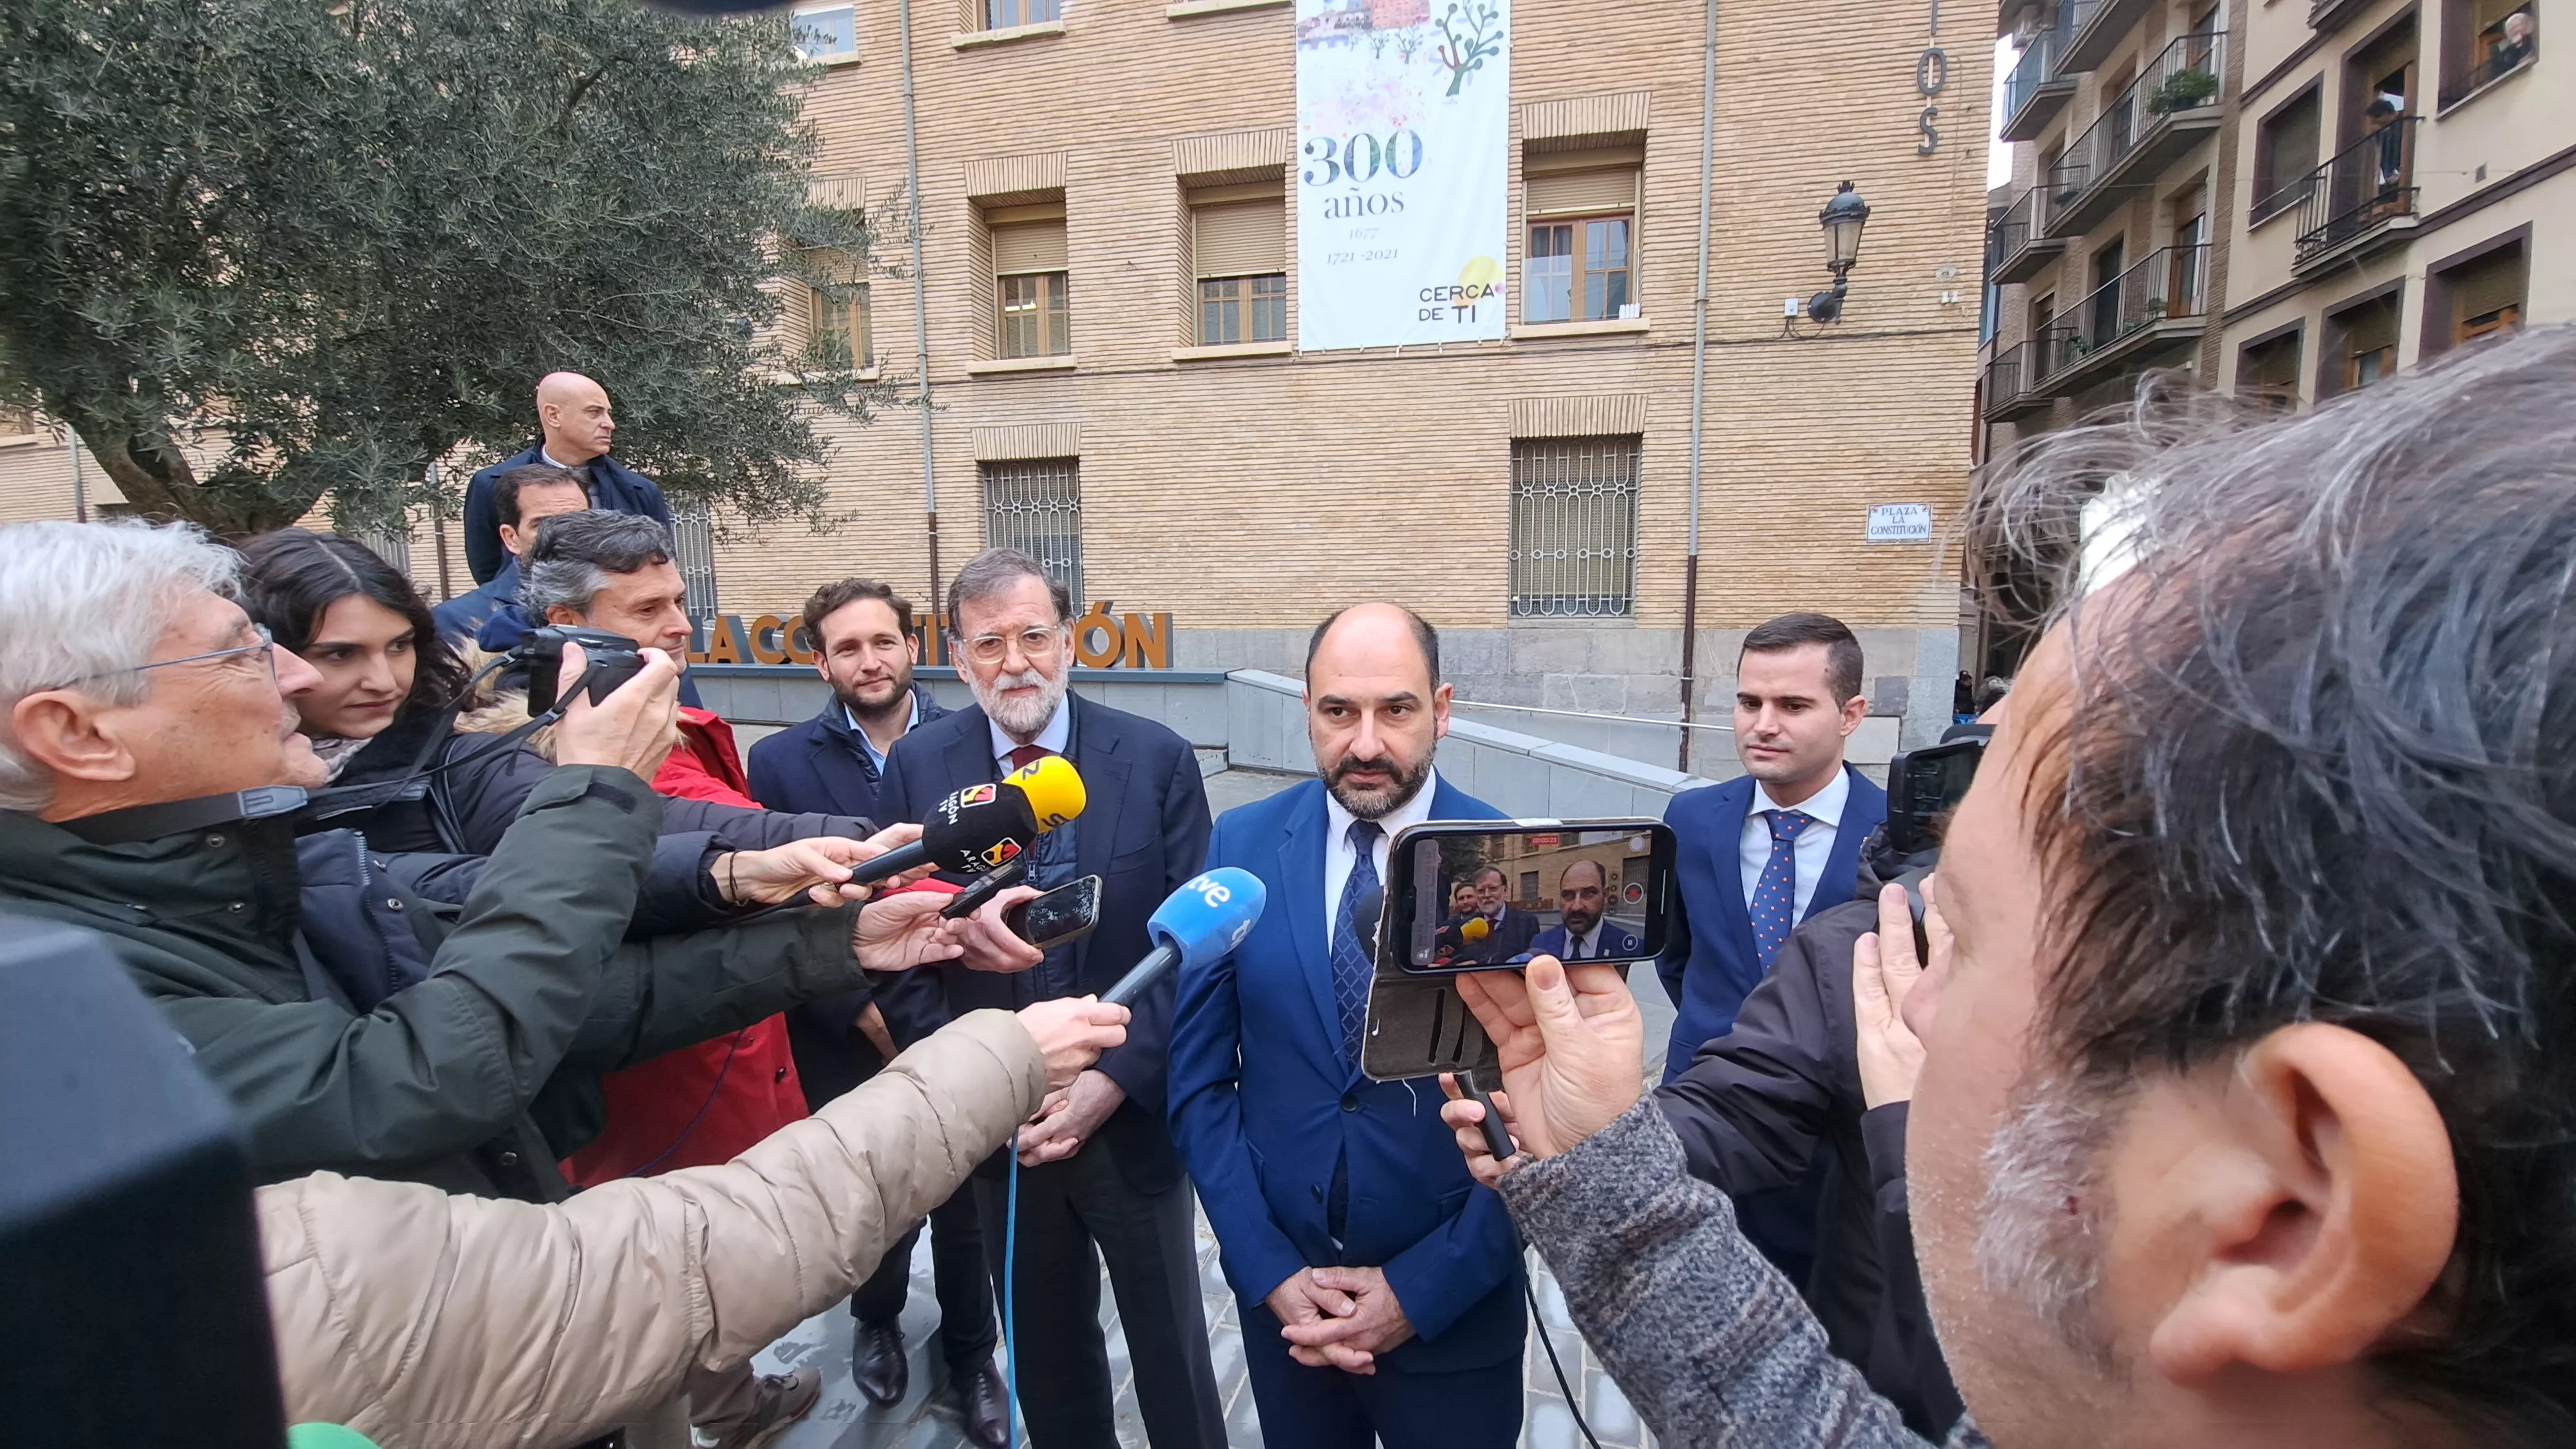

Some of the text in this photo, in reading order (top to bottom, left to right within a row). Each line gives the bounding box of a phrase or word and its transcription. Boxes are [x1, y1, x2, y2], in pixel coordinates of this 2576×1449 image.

[1303, 129, 1423, 187] 300
[1324, 187, 1405, 220] años
[1349, 227, 1379, 241] 1677
[1327, 252, 1355, 265] 1721
[1419, 283, 1495, 303] CERCA
[1419, 304, 1476, 324] DE TI
[1881, 507, 1918, 516] PLAZA
[1891, 516, 1905, 524] LA
[1870, 524, 1927, 535] CONSTITUCIÓN
[1188, 875, 1231, 909] tve
